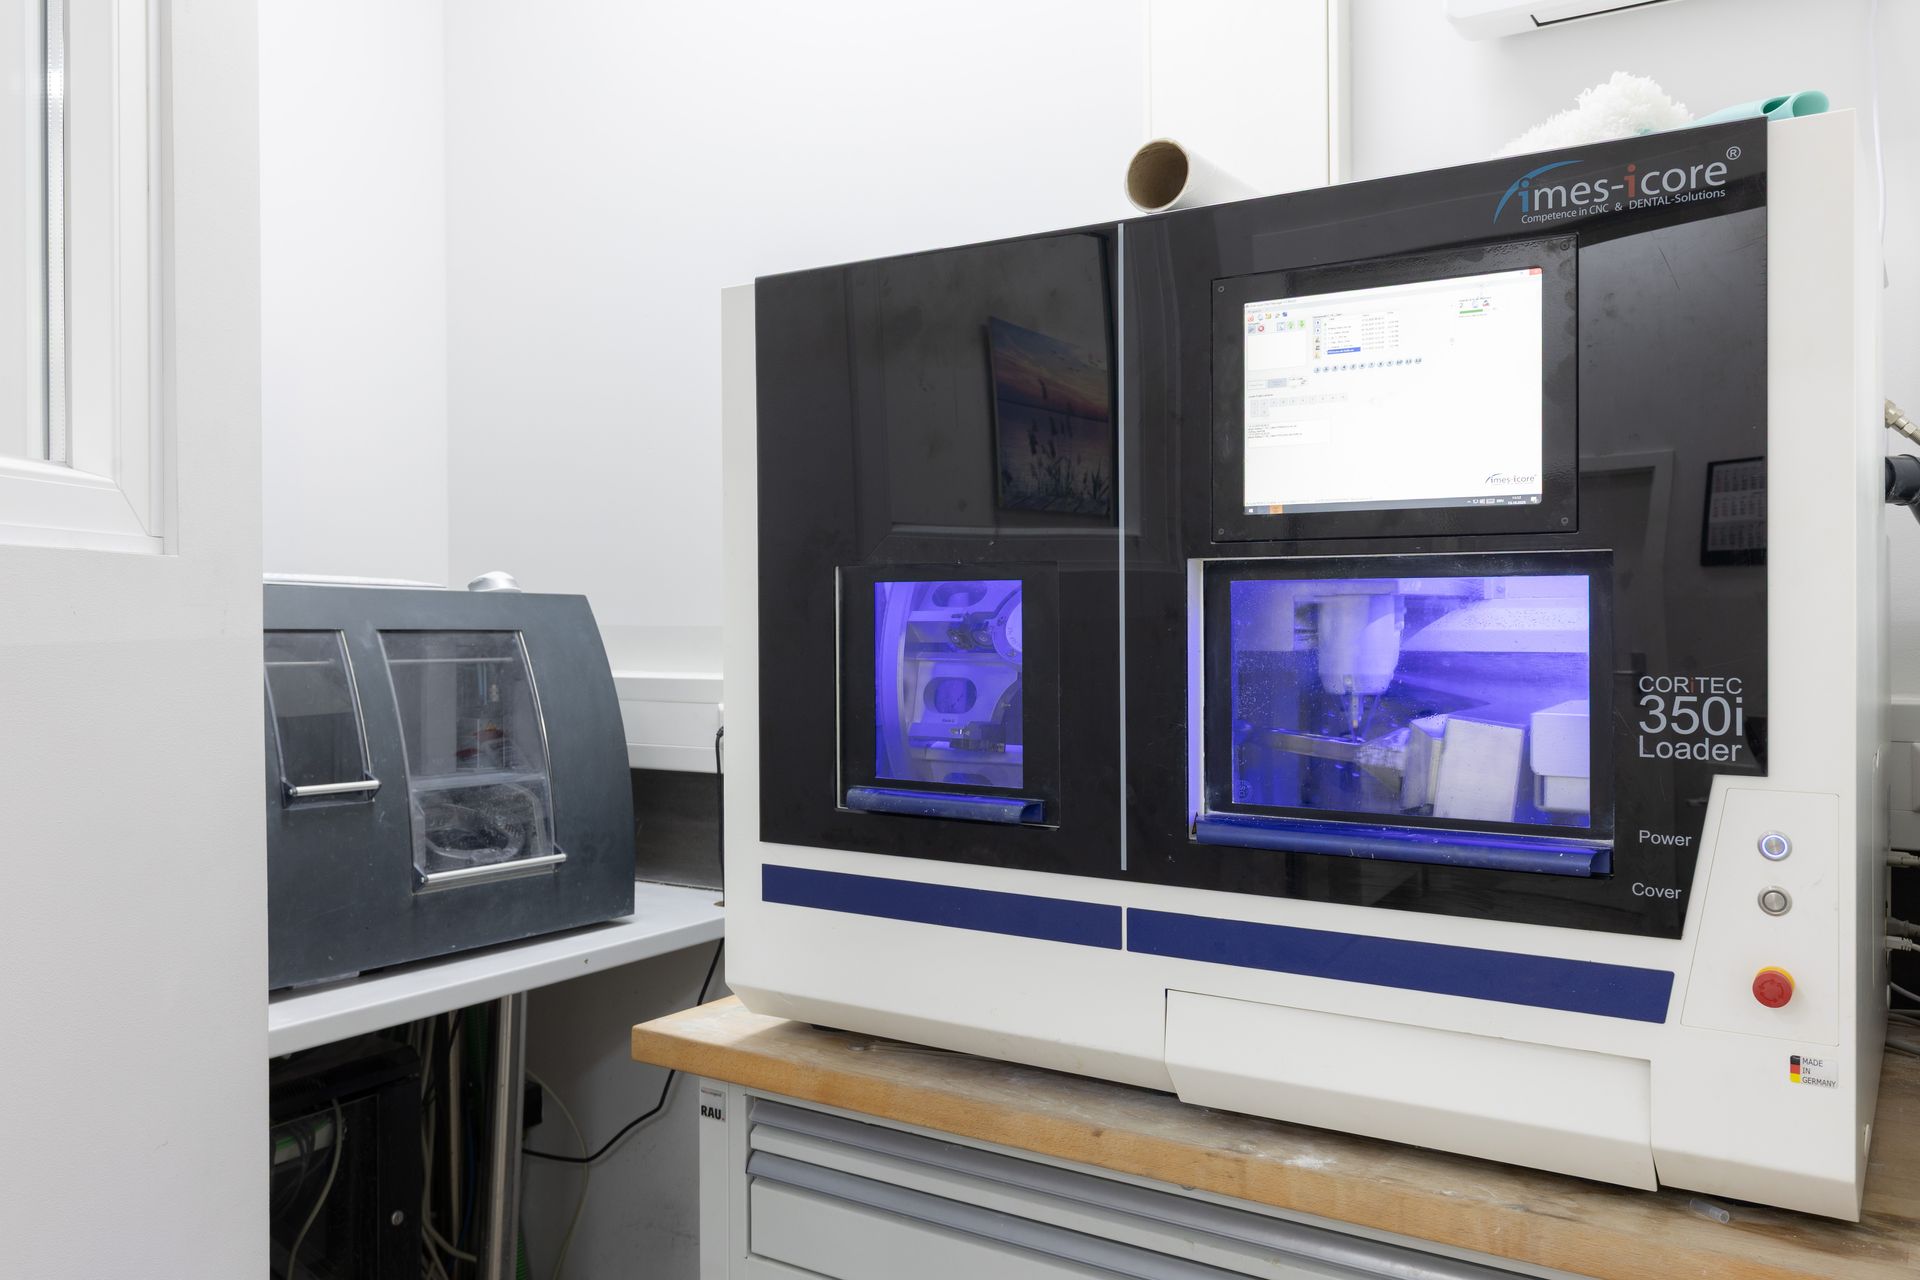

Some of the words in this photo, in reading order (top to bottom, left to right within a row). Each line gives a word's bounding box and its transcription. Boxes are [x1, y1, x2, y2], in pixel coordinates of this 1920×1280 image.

[1517, 163, 1728, 213] imes-icore
[1521, 209, 1577, 225] Competence
[1578, 206, 1588, 216] in
[1589, 204, 1609, 214] CNC
[1614, 202, 1623, 212] &
[1629, 188, 1726, 210] DENTAL-Solutions
[1639, 676, 1743, 694] CORiTEC
[1639, 695, 1743, 736] 350i
[1639, 735, 1742, 761] Loader
[1639, 830, 1692, 847] Power
[1632, 882, 1682, 899] Cover
[1802, 1057, 1823, 1067] MADE
[1802, 1077, 1836, 1087] GERMANY
